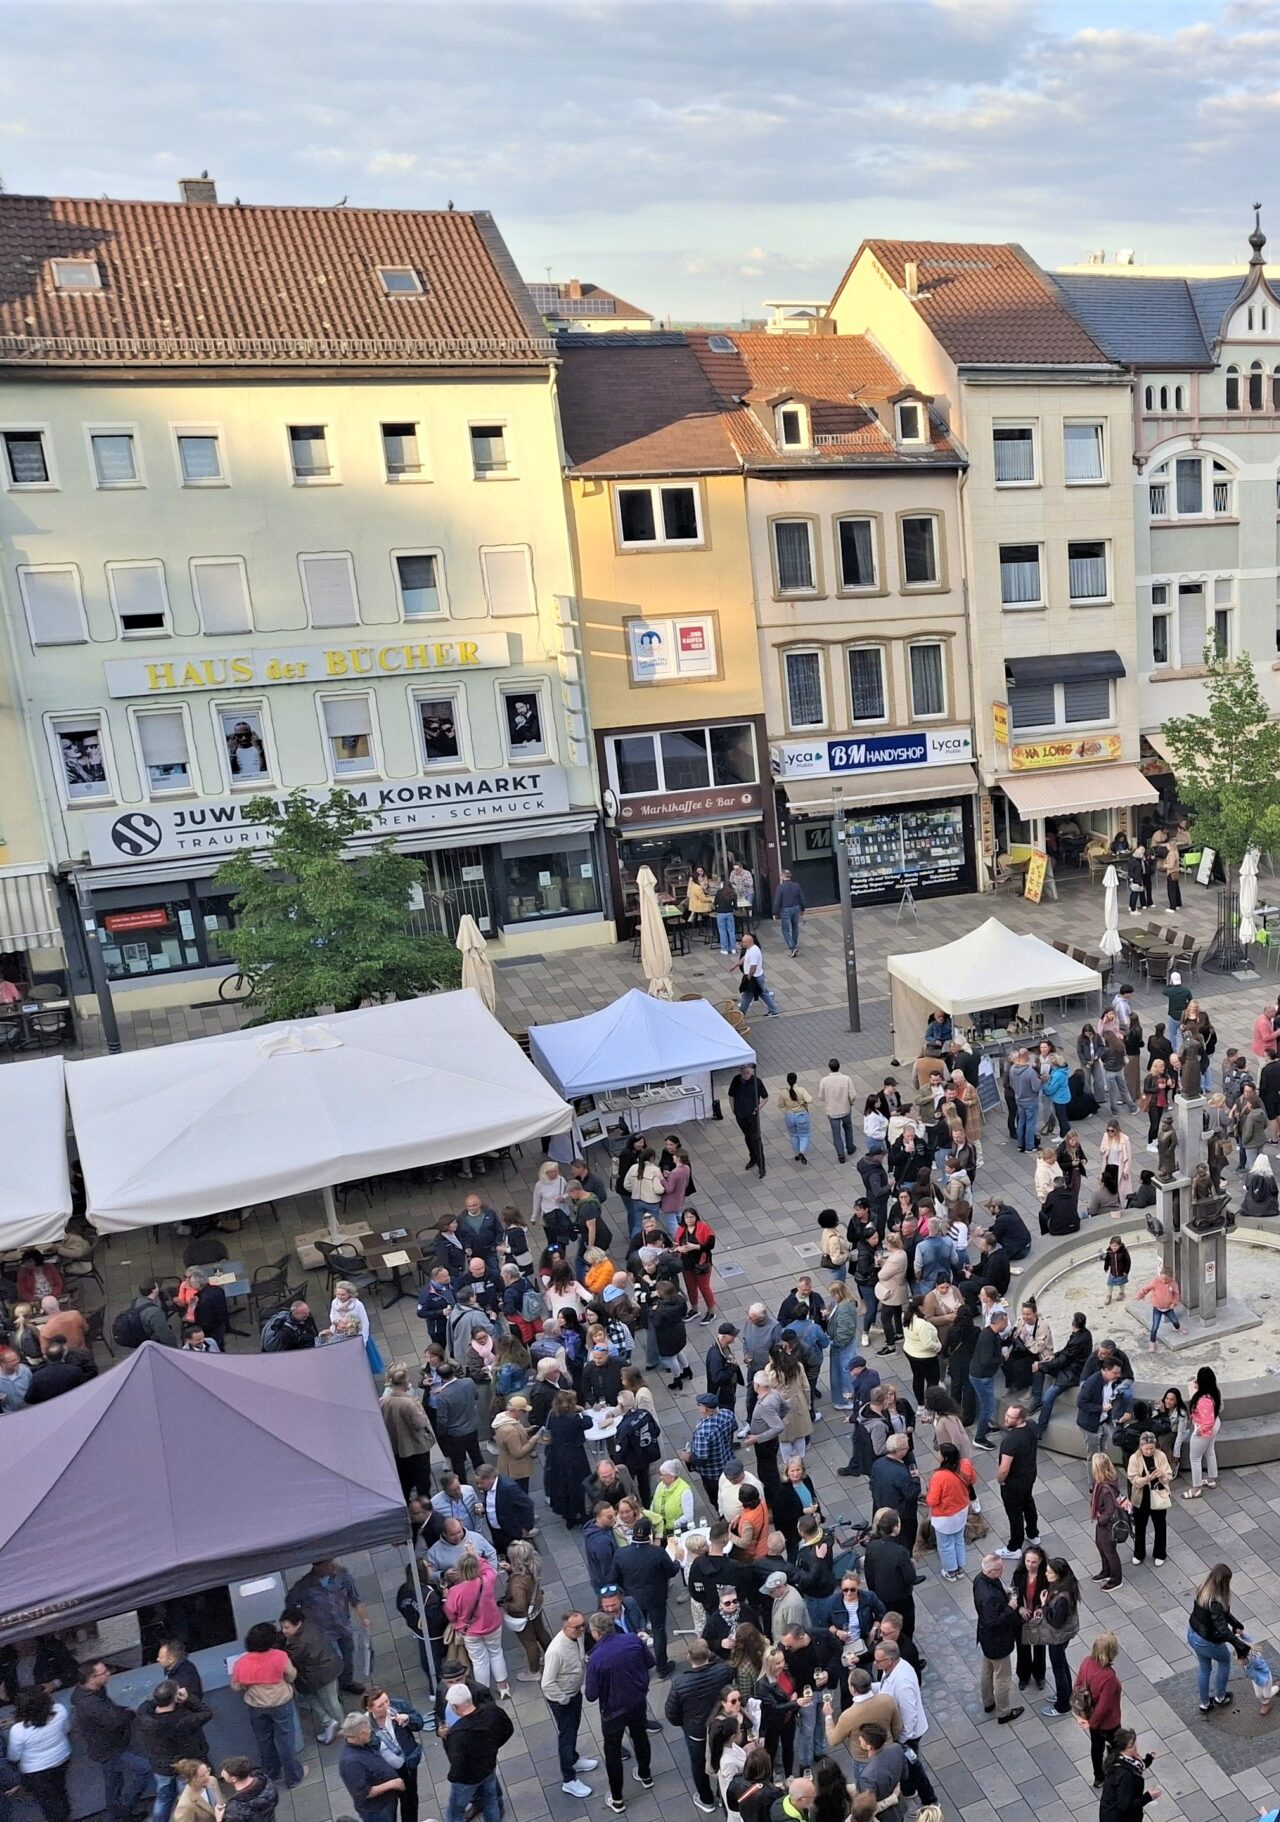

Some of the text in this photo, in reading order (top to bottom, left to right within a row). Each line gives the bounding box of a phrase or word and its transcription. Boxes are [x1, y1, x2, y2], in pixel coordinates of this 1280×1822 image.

[145, 641, 481, 690] HAUS der BÜCHER
[831, 744, 924, 766] BM HANDYSHOP
[932, 738, 961, 754] Lyca
[1043, 744, 1073, 758] LONG
[379, 774, 541, 806] KORNMARKT
[450, 799, 546, 818] SCHMUCK
[640, 797, 736, 816] Marktkaffee & Bar
